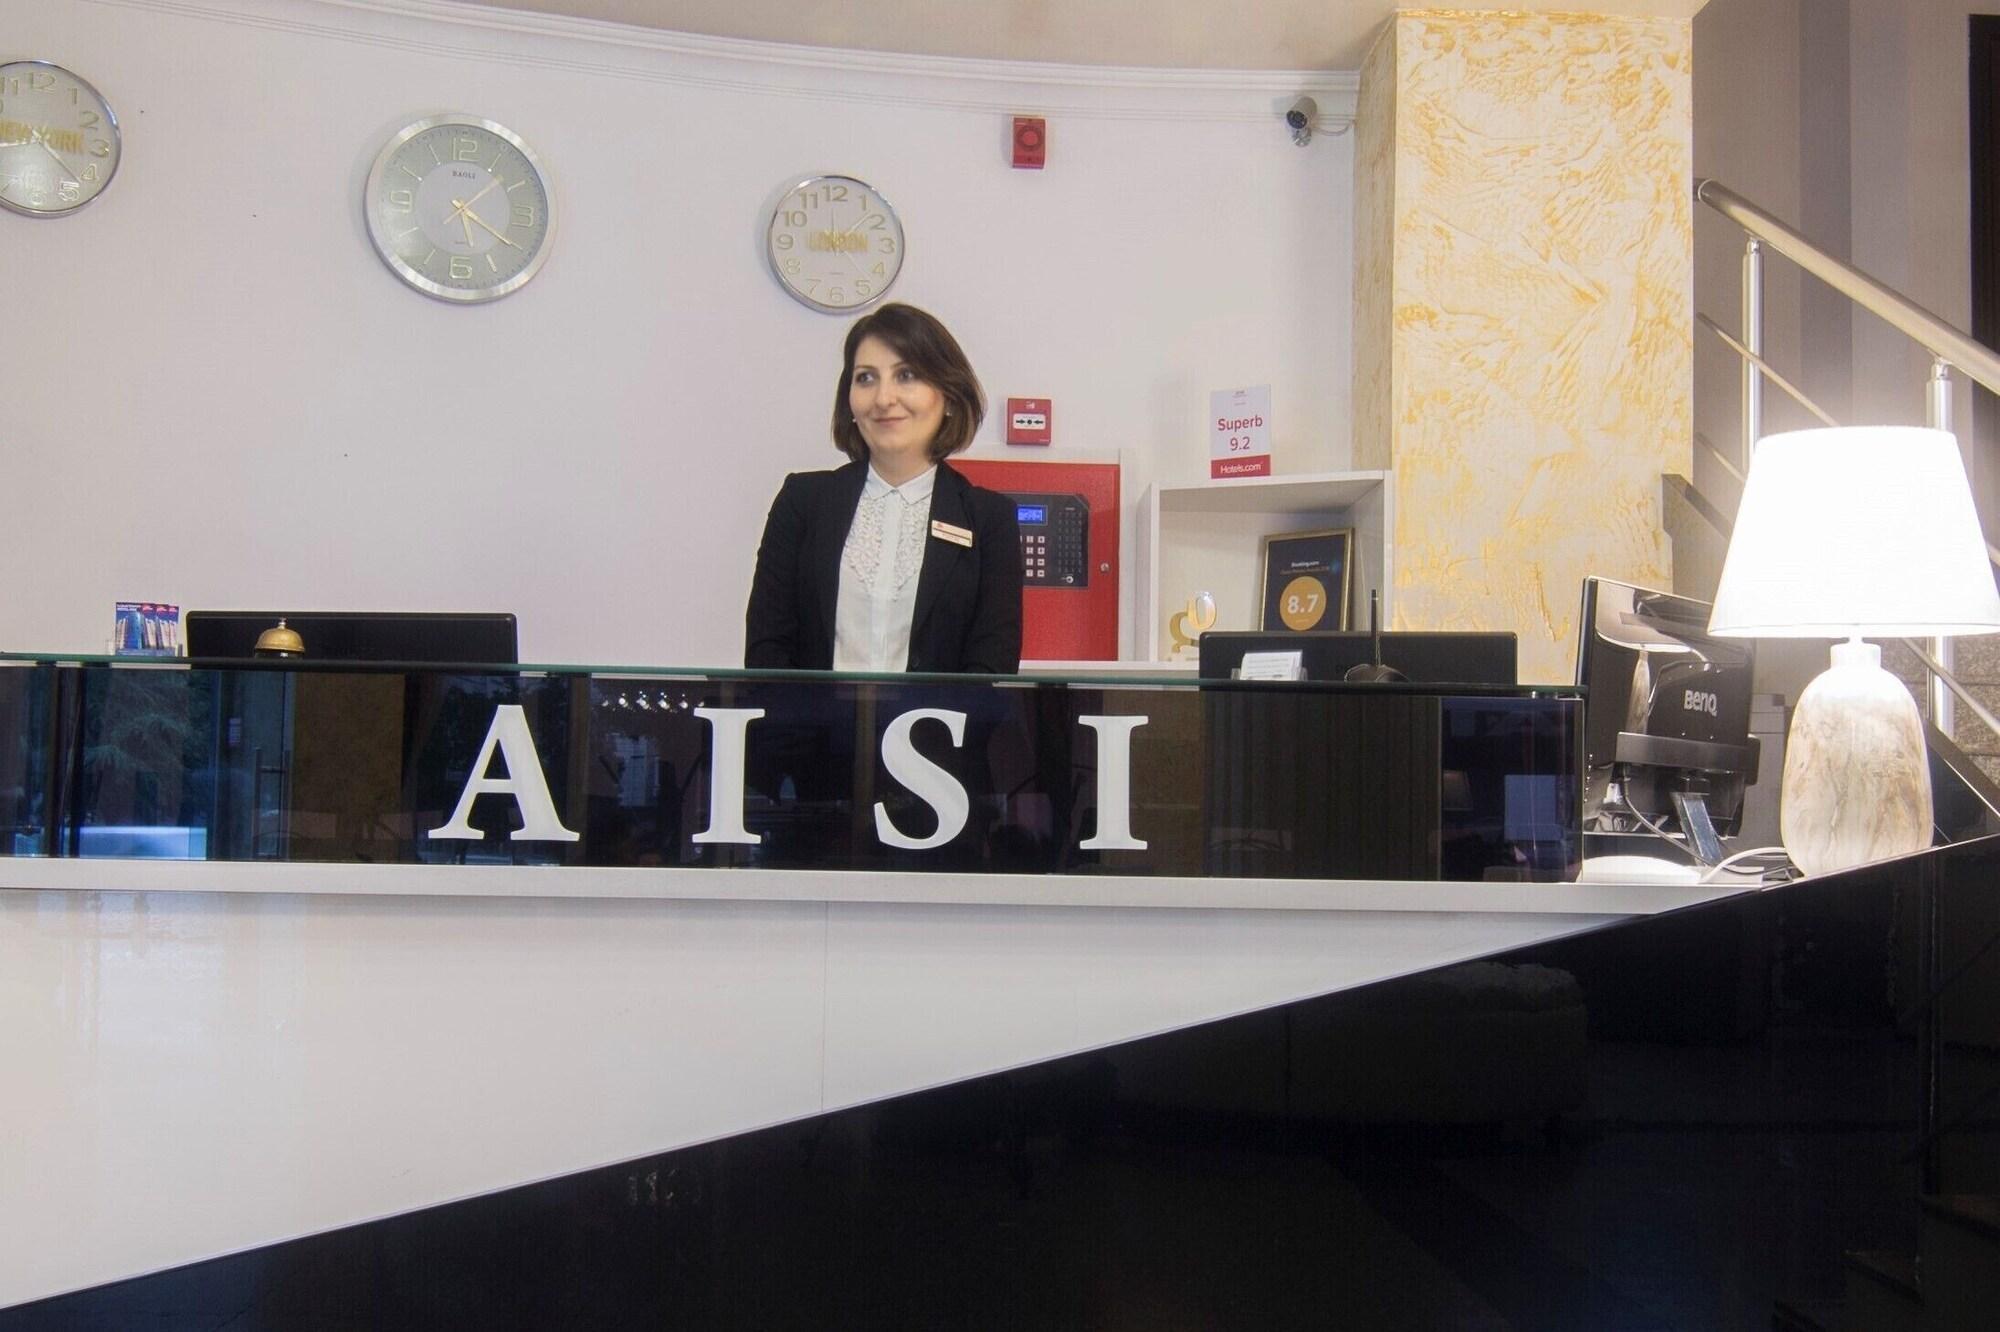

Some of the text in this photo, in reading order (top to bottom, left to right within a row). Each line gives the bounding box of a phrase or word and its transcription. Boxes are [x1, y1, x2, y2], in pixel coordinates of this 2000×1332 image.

[27, 72, 56, 93] 12
[67, 87, 78, 105] 1
[79, 110, 99, 131] 2
[90, 139, 110, 158] 3
[452, 137, 481, 162] 12
[80, 163, 98, 183] 4
[58, 180, 80, 201] 5
[822, 184, 848, 202] 12
[390, 189, 413, 214] 9
[799, 192, 818, 209] 11
[858, 193, 868, 211] 1
[511, 203, 535, 228] 3
[783, 210, 808, 228] 10
[870, 213, 887, 230] 2
[777, 233, 794, 250] 9
[878, 237, 896, 254] 3
[448, 255, 473, 280] 6
[785, 257, 801, 275] 8
[871, 261, 886, 279] 4
[805, 278, 823, 296] 7
[829, 286, 846, 304] 6
[855, 279, 872, 297] 5
[1217, 415, 1263, 432] Superb
[1229, 436, 1251, 452] 9.2
[1220, 463, 1262, 475] Hotels.com
[1287, 593, 1319, 615] 8.7
[1683, 689, 1718, 717] BenQ
